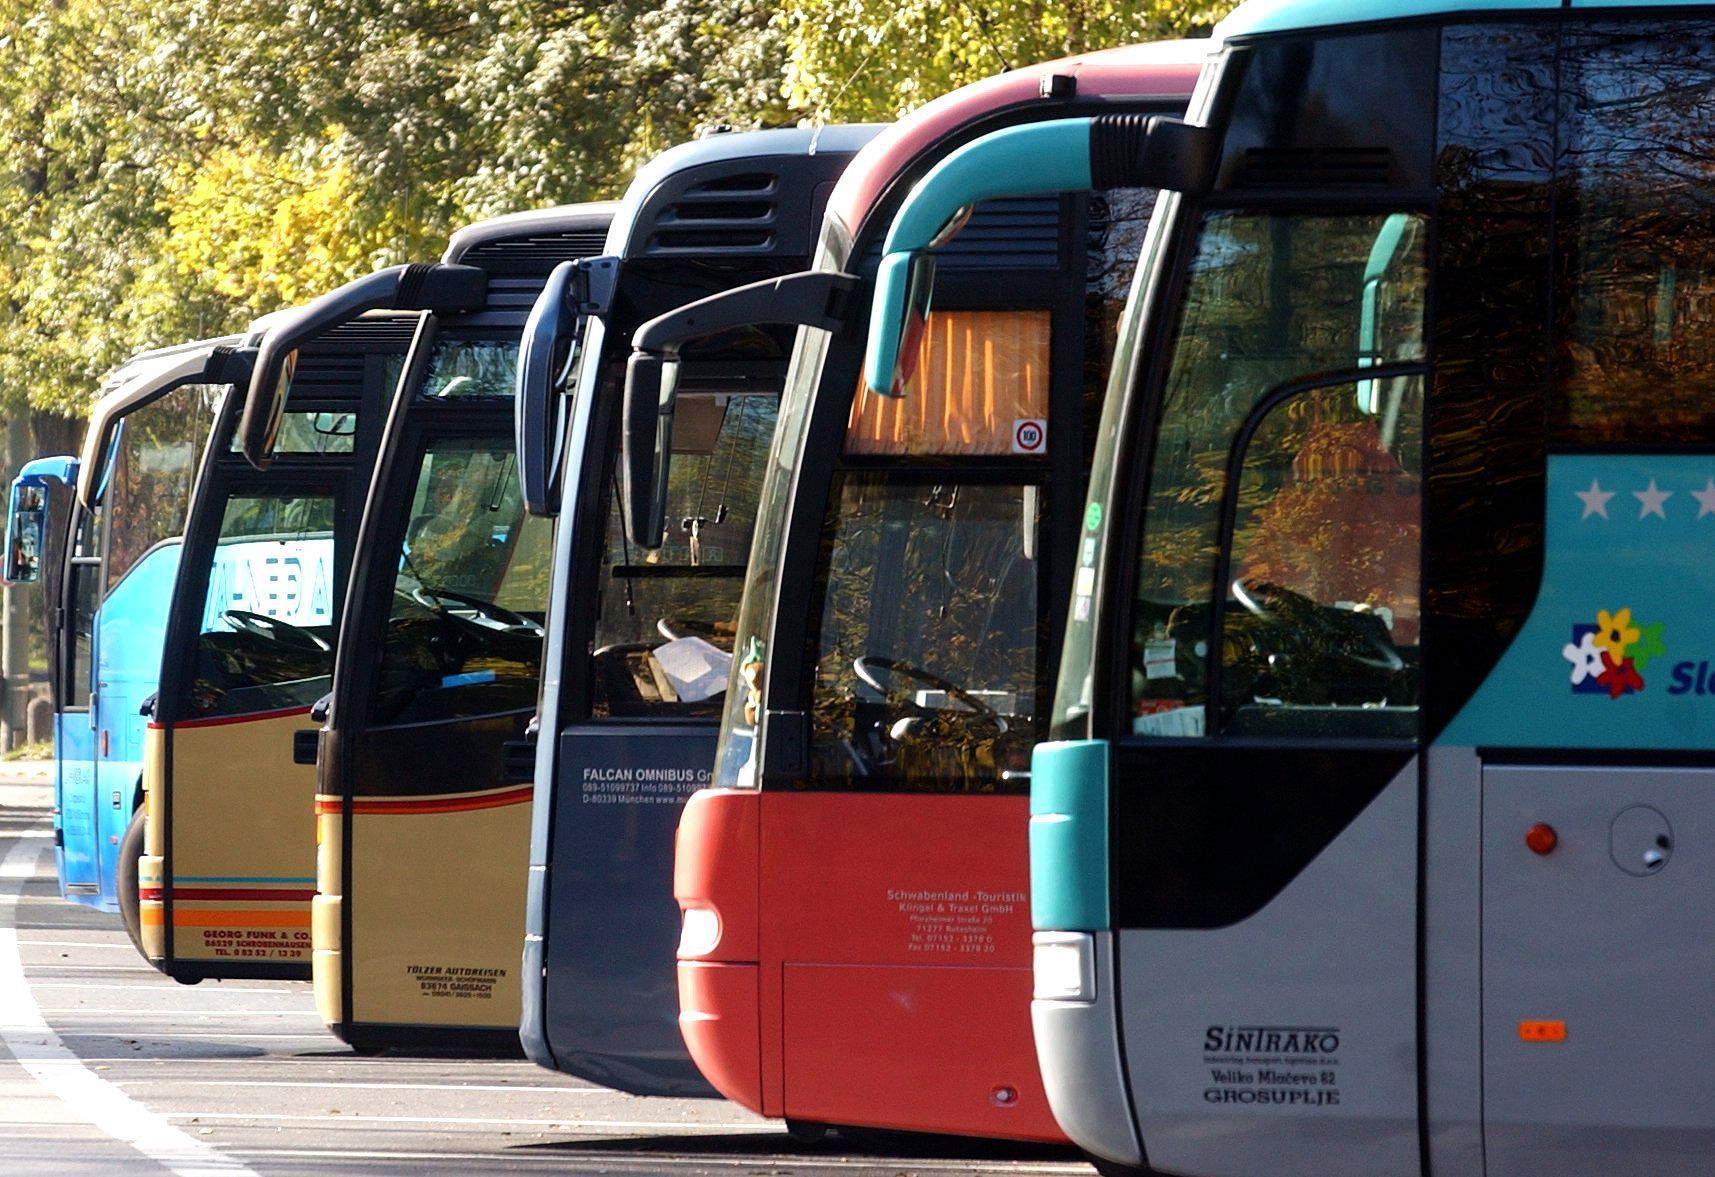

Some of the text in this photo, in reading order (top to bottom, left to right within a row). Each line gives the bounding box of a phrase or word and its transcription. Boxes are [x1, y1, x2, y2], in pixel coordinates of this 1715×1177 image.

[1023, 430, 1037, 441] 100
[583, 768, 633, 781] FALCAN
[635, 768, 694, 781] OMNIBUS
[887, 889, 969, 900] Schwabenland
[936, 903, 945, 912] &
[981, 904, 1014, 914] GmbH
[203, 930, 242, 939] GEORG
[247, 931, 277, 939] FUNK
[280, 931, 288, 940] &
[445, 966, 507, 978] AUTOREISEN
[1211, 1070, 1254, 1084] Veliko
[1320, 1071, 1336, 1085] 82
[1204, 1087, 1340, 1106] GROSUPLJE
